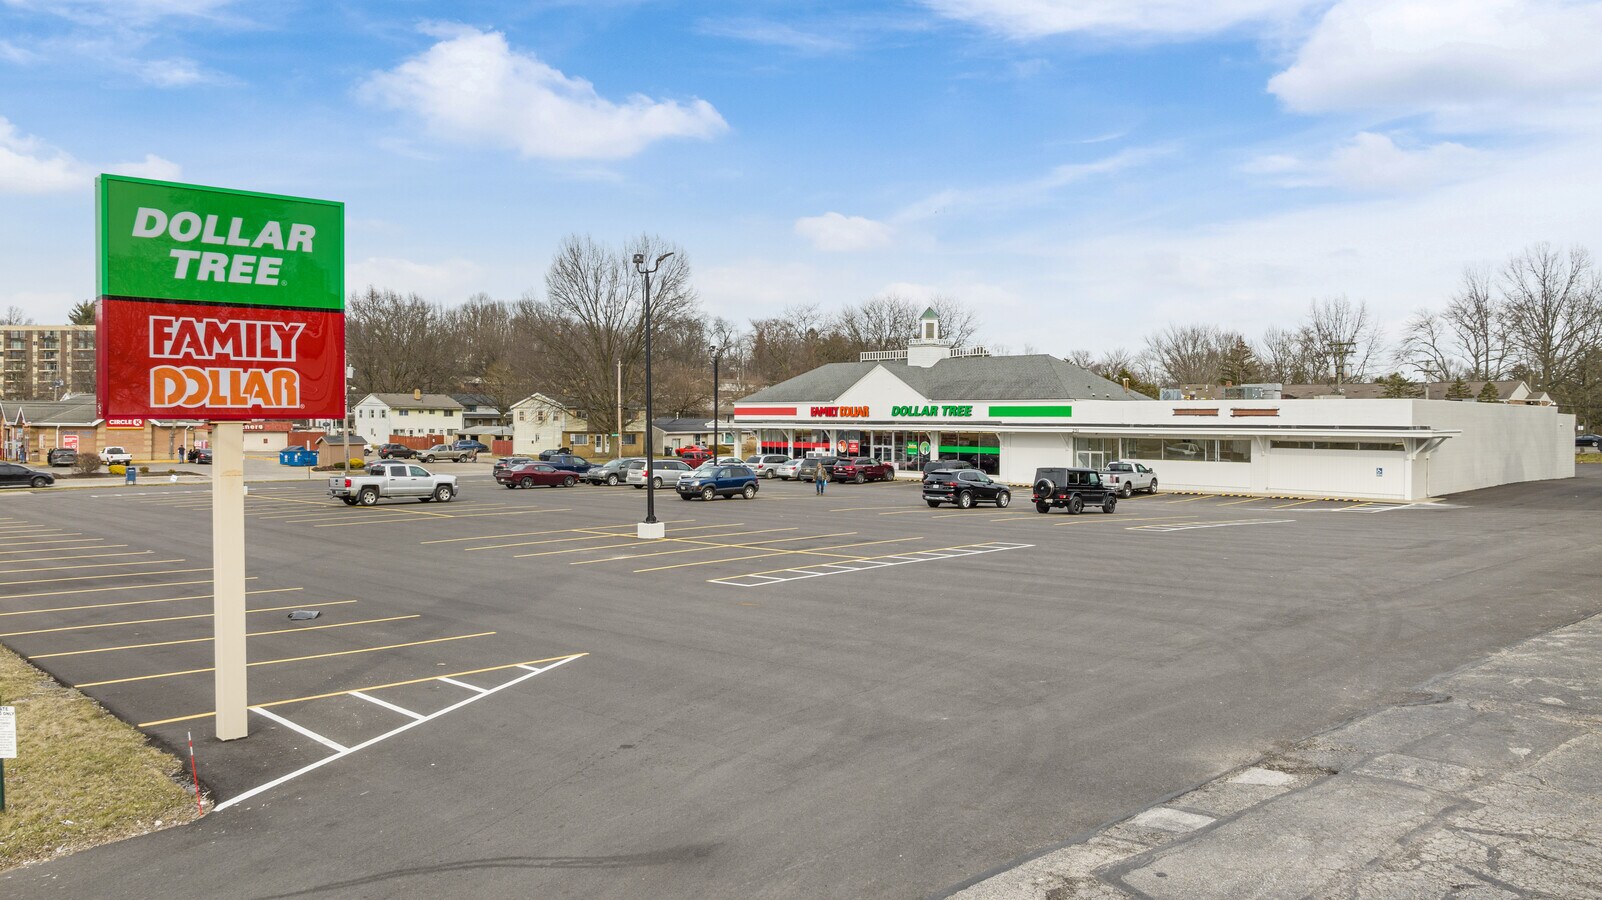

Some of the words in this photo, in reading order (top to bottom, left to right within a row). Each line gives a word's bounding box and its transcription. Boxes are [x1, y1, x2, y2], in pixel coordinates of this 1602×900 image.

[131, 206, 316, 253] DOLLAR
[169, 248, 284, 286] TREE
[149, 315, 307, 362] FAMILY
[150, 364, 300, 409] DOLLAR
[133, 418, 142, 426] K
[810, 406, 838, 417] FAMILY
[839, 406, 870, 417] DOLLAR
[891, 405, 938, 417] DOLLAR
[942, 405, 973, 417] TREE
